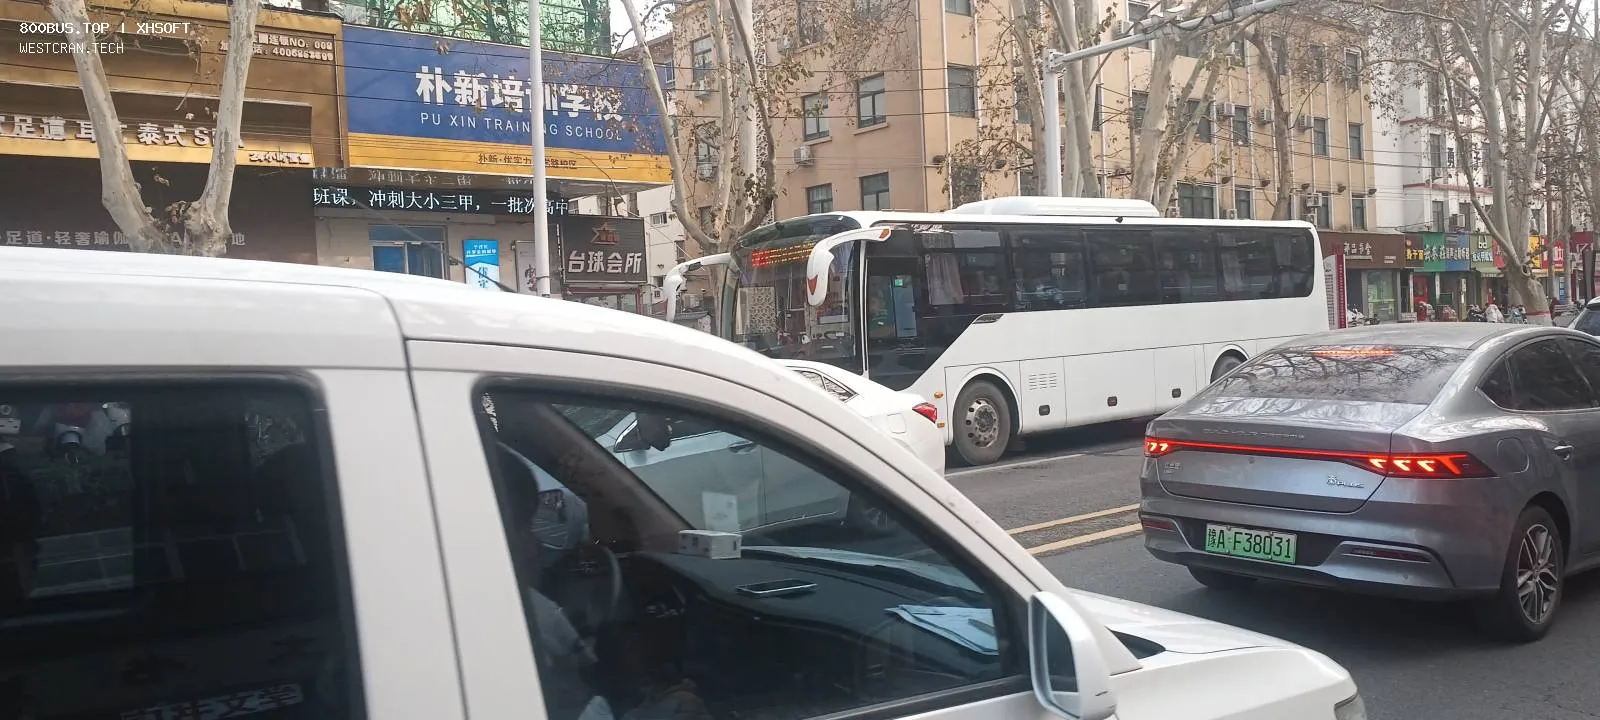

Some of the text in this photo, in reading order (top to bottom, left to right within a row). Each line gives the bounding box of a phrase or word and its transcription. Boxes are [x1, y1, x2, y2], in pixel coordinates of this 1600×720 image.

[415, 66, 623, 122] 朴新培训学校
[0, 114, 66, 141] 足道
[137, 123, 187, 147] 泰式
[421, 113, 622, 141] PU XIN TRAING SCHOOL
[568, 250, 643, 275] 台球会所
